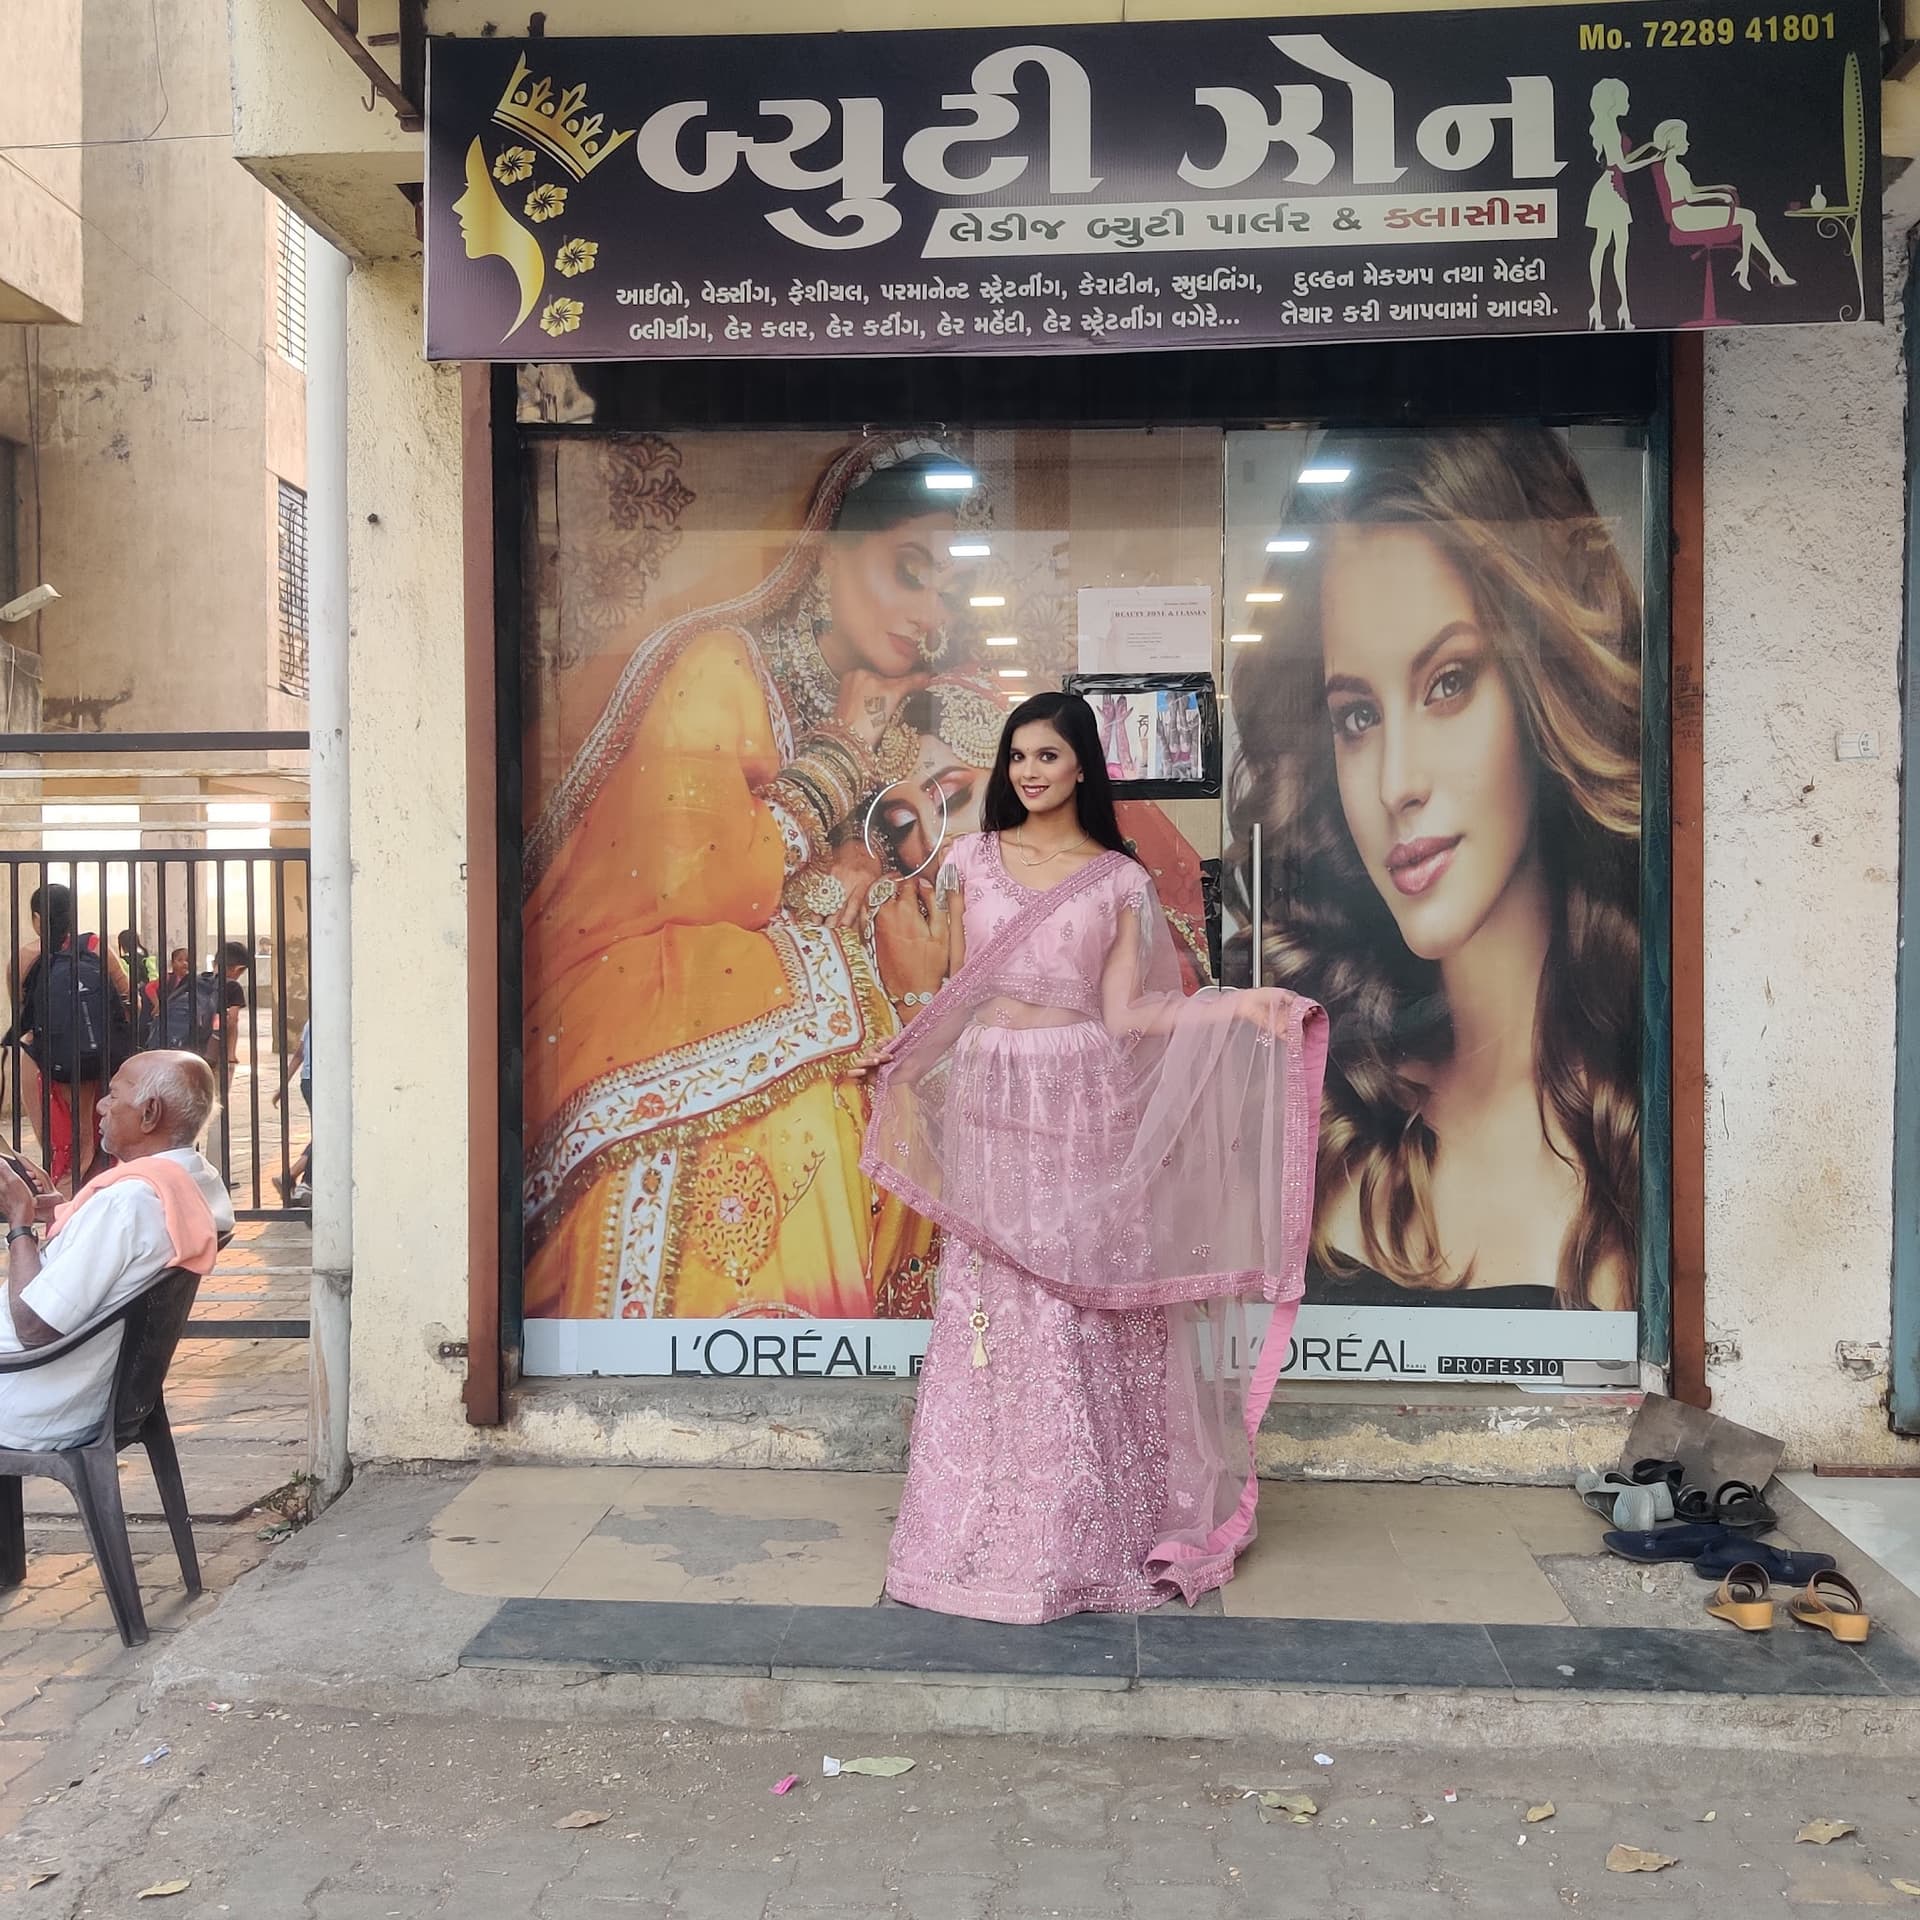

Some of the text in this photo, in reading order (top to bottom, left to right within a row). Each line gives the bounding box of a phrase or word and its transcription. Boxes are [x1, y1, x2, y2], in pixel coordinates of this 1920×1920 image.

[1580, 13, 1833, 50] Mo. 72289 41801
[637, 34, 1568, 250] બ્યુટી ઝોન
[950, 197, 1545, 248] લેડીજ બ્યુટી પાર્લર & ક્લાસીસ
[880, 276, 969, 300] પરમાનેન્ટ
[1079, 272, 1160, 297] કેરાટીન,
[1364, 263, 1433, 286] મેકઅપ
[1443, 266, 1483, 283] તથા
[724, 315, 752, 339] હેર
[761, 322, 815, 341] કલર,
[826, 313, 853, 338] હેર
[937, 312, 964, 336] હેર
[1043, 308, 1071, 333] હેર
[1281, 292, 1558, 324] તૈયાર કરી આપવામાં આવશે.
[671, 1328, 896, 1376] L'ORÉAL
